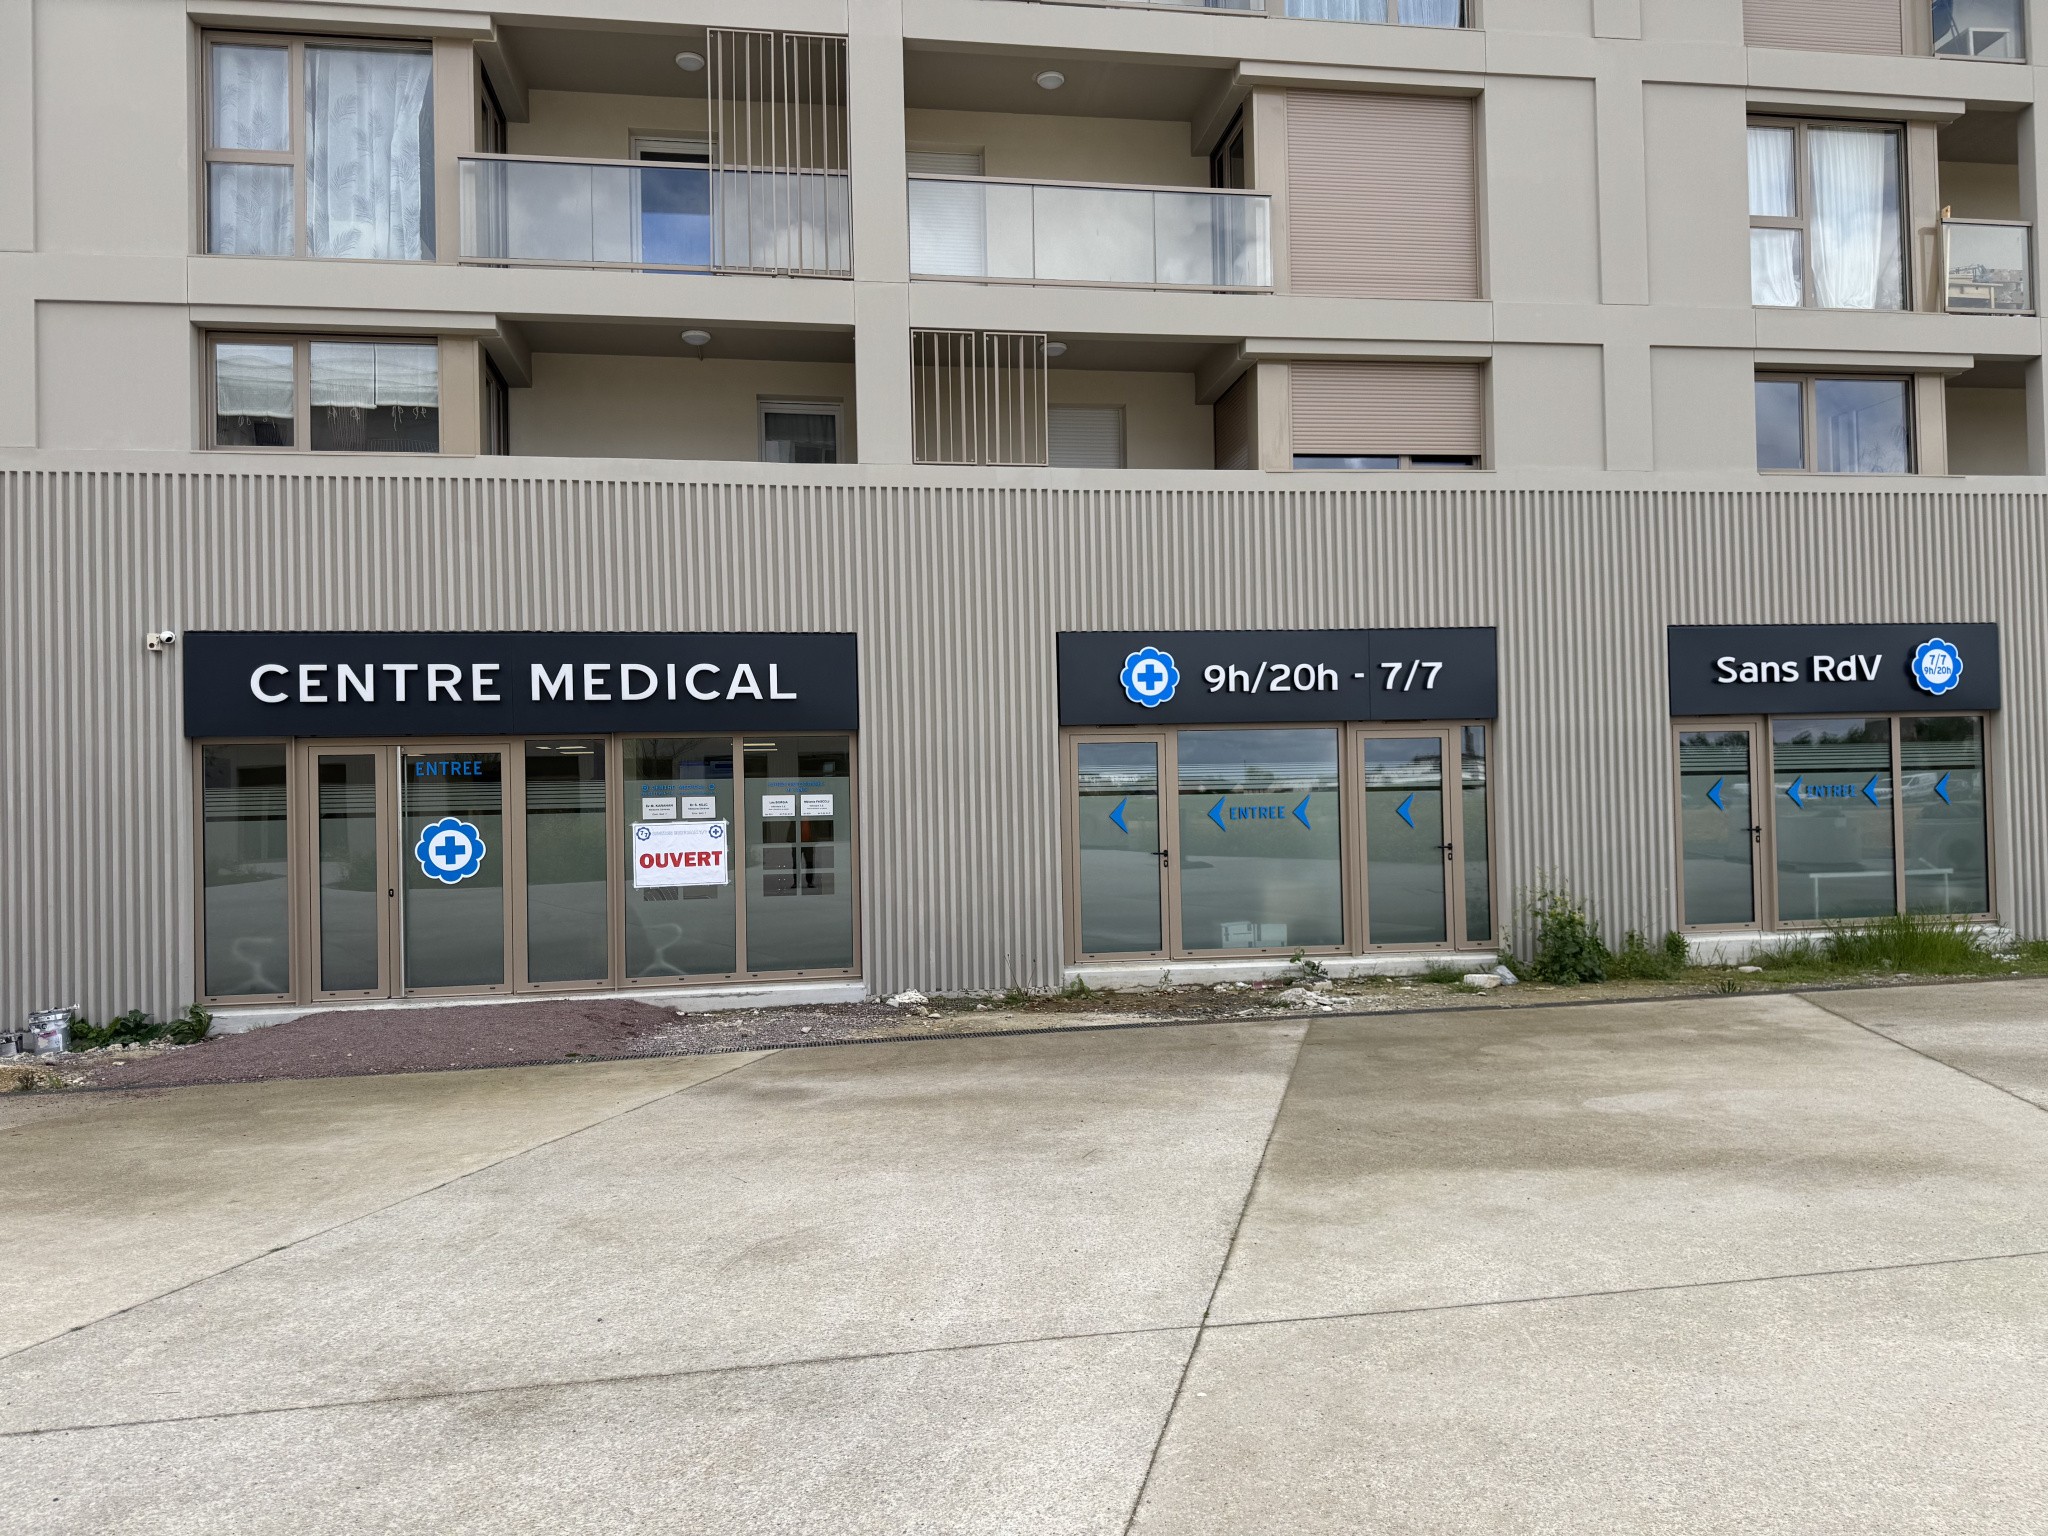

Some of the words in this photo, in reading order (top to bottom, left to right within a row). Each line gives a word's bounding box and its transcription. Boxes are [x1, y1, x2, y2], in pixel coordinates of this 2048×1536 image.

[1929, 653, 1947, 666] 7/7
[1203, 661, 1339, 694] 9h/20h
[1380, 659, 1443, 692] 7/7
[1716, 656, 1800, 684] Sans
[1812, 654, 1883, 682] RdV
[1923, 666, 1952, 675] 9h/20h
[250, 663, 501, 704] CENTRE
[531, 662, 797, 702] MEDICAL
[415, 761, 482, 777] ENTREE
[1229, 805, 1286, 821] ENTREE
[639, 850, 723, 869] OUVERT
